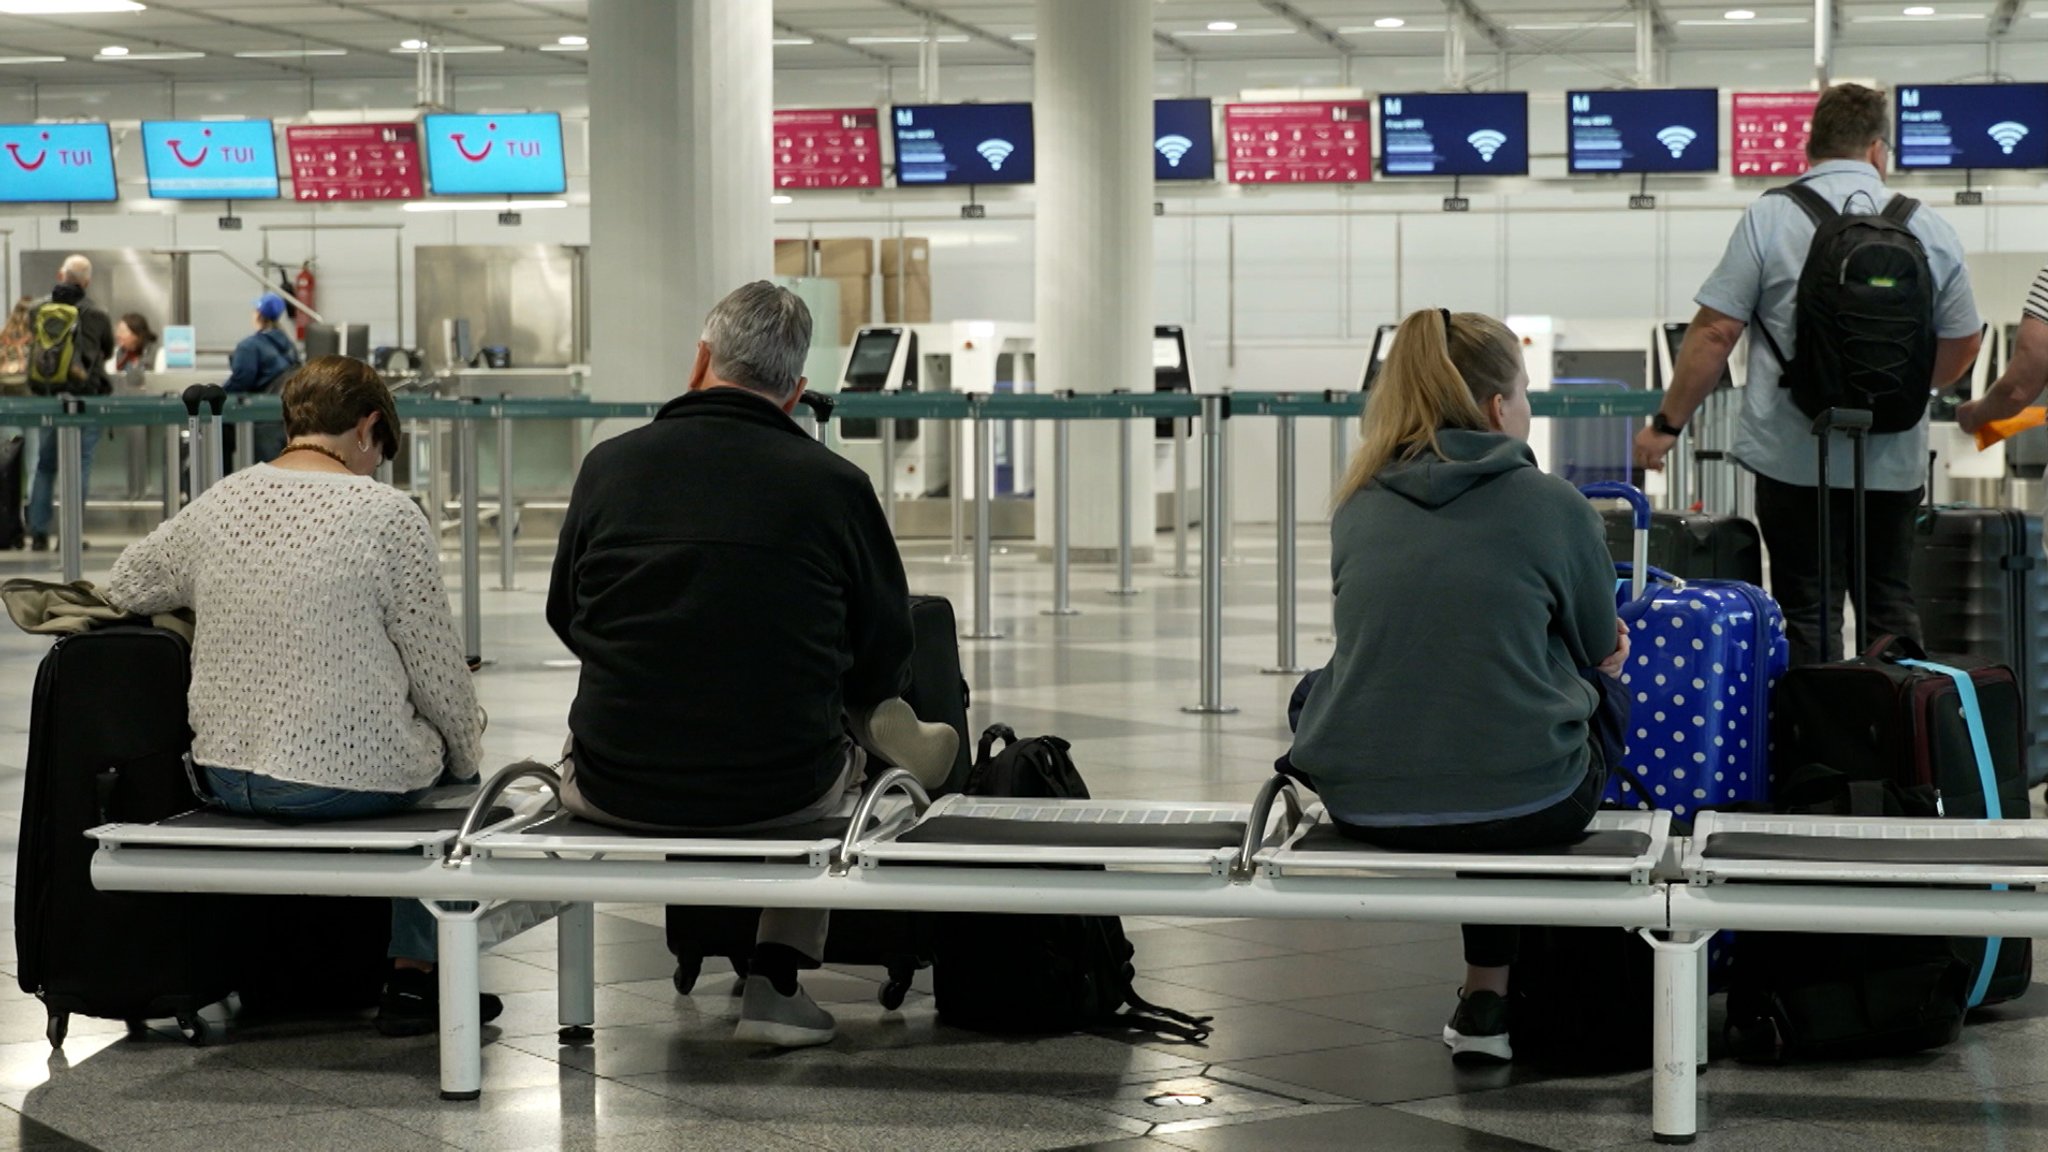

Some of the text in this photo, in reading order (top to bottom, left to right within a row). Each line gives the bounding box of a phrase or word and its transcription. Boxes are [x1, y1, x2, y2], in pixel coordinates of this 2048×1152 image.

[222, 147, 254, 162] TUI
[507, 142, 540, 157] TUI
[59, 151, 92, 166] TUI
